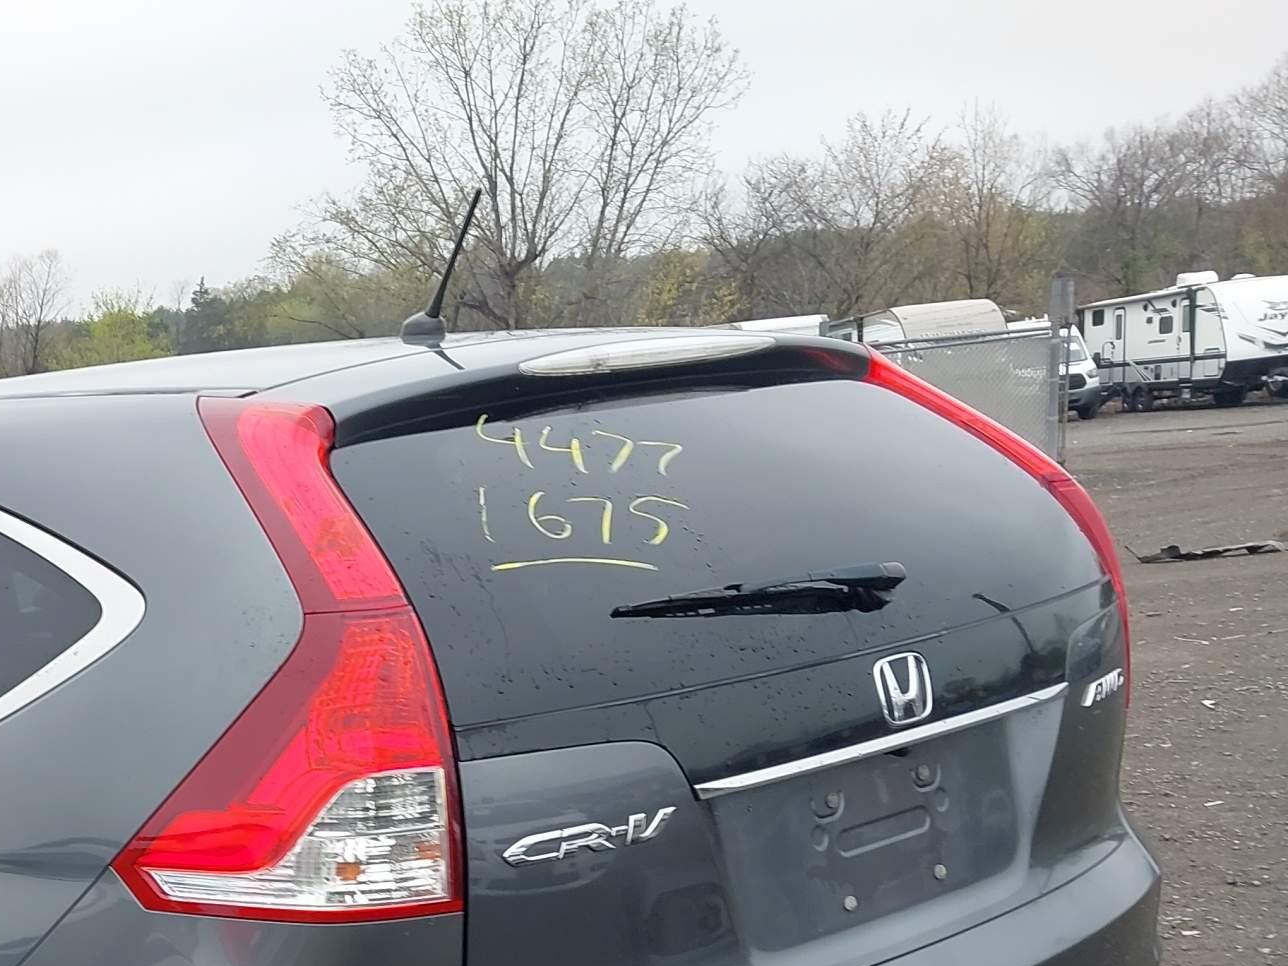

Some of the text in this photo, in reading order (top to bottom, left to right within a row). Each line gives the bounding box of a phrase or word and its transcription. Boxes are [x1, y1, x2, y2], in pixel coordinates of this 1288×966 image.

[476, 413, 684, 477] 4477
[478, 485, 690, 545] 1675
[502, 806, 678, 866] CR-V
